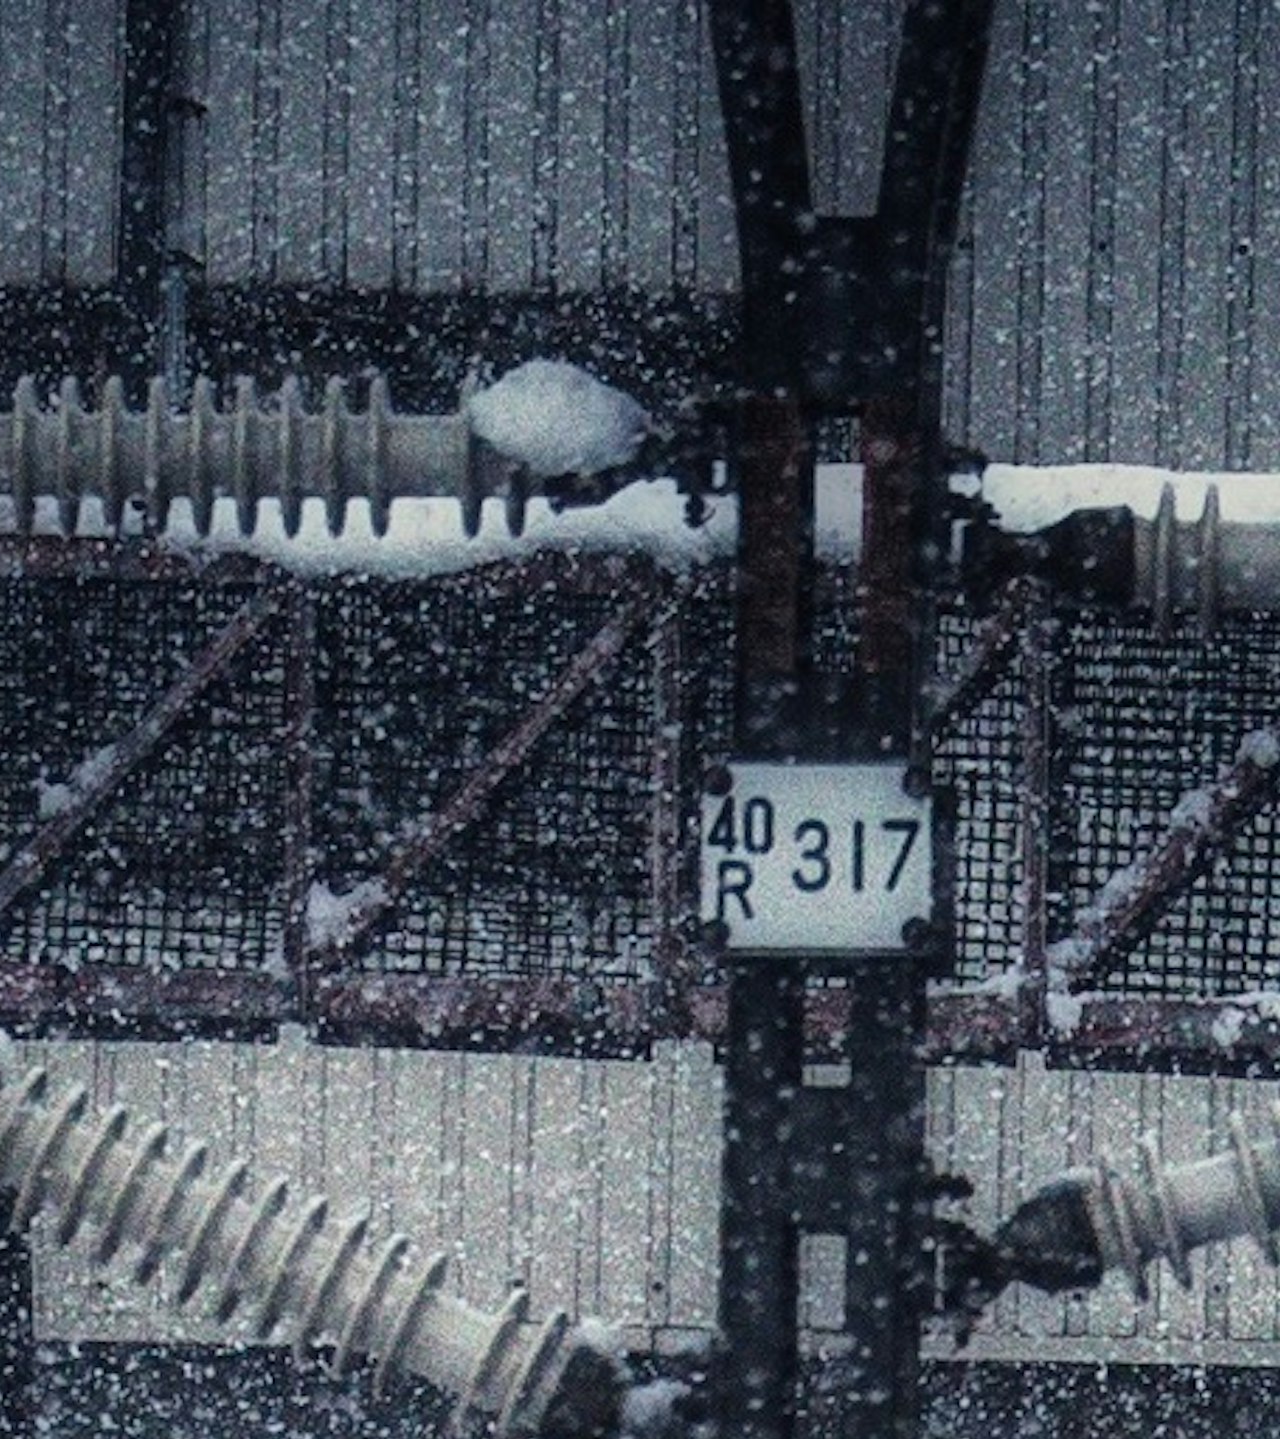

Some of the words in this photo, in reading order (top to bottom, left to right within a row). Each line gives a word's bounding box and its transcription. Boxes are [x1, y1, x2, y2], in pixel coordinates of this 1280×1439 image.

[707, 796, 775, 855] 40
[792, 818, 921, 893] 317
[716, 860, 754, 920] R
